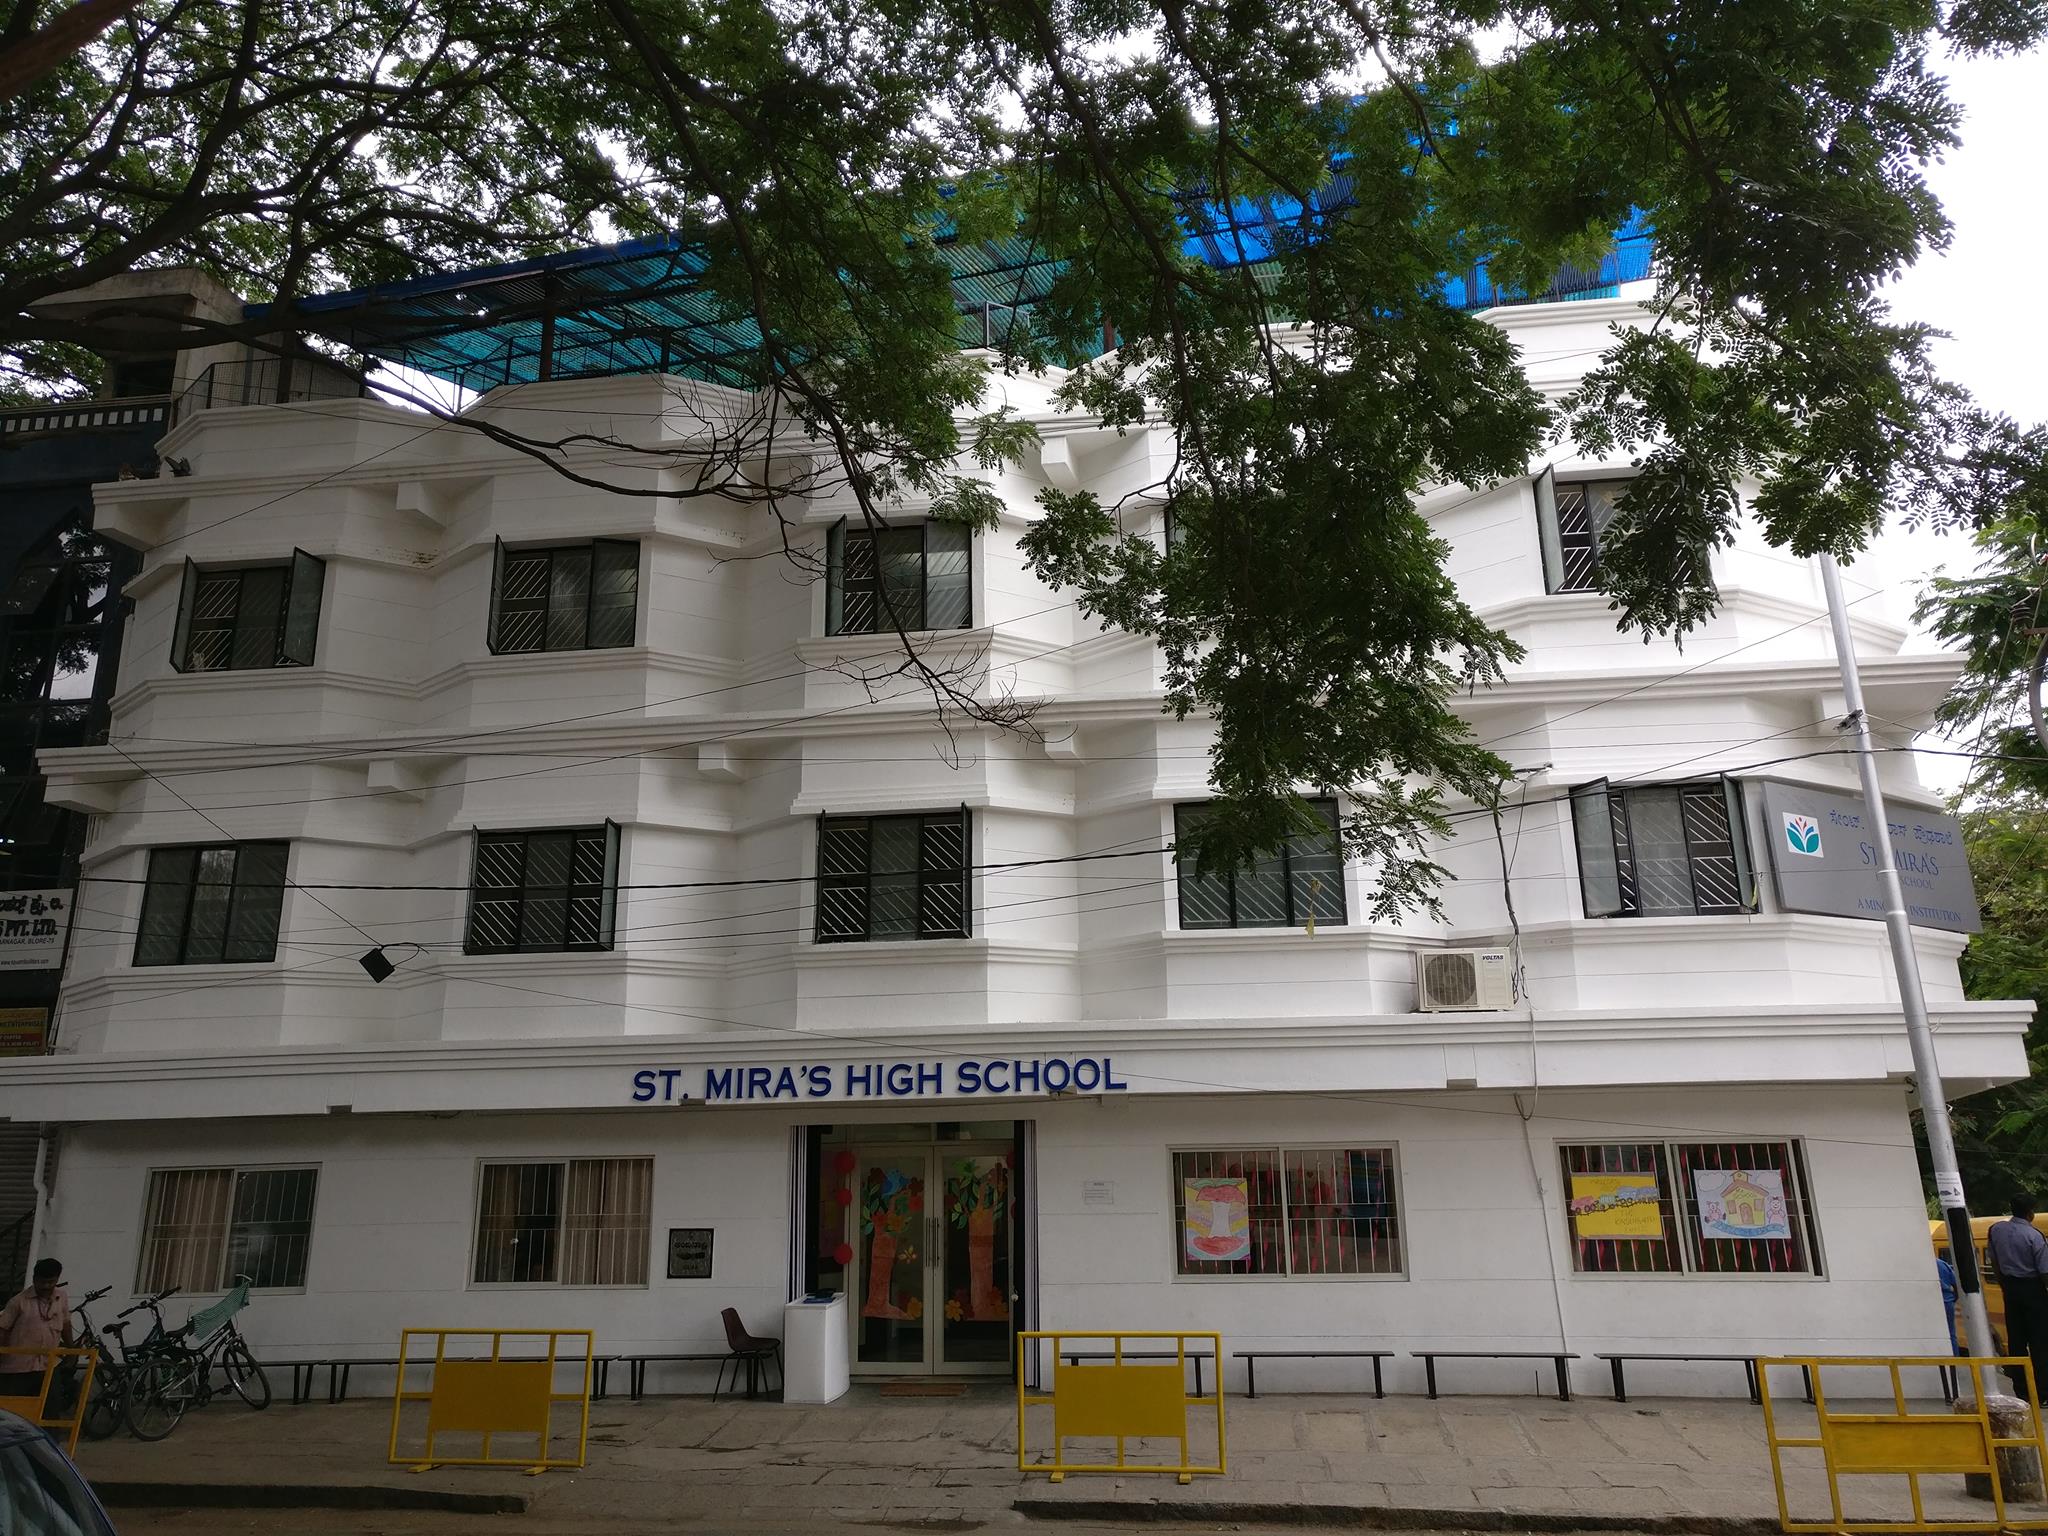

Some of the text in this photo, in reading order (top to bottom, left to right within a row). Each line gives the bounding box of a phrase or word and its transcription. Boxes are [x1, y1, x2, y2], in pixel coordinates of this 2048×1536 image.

[1909, 905, 1961, 922] INSTITUTION
[5, 920, 30, 937] PVT.
[32, 919, 58, 936] LTD.
[632, 1057, 1128, 1102] ST. MIRA'S HIGH SCHOOL
